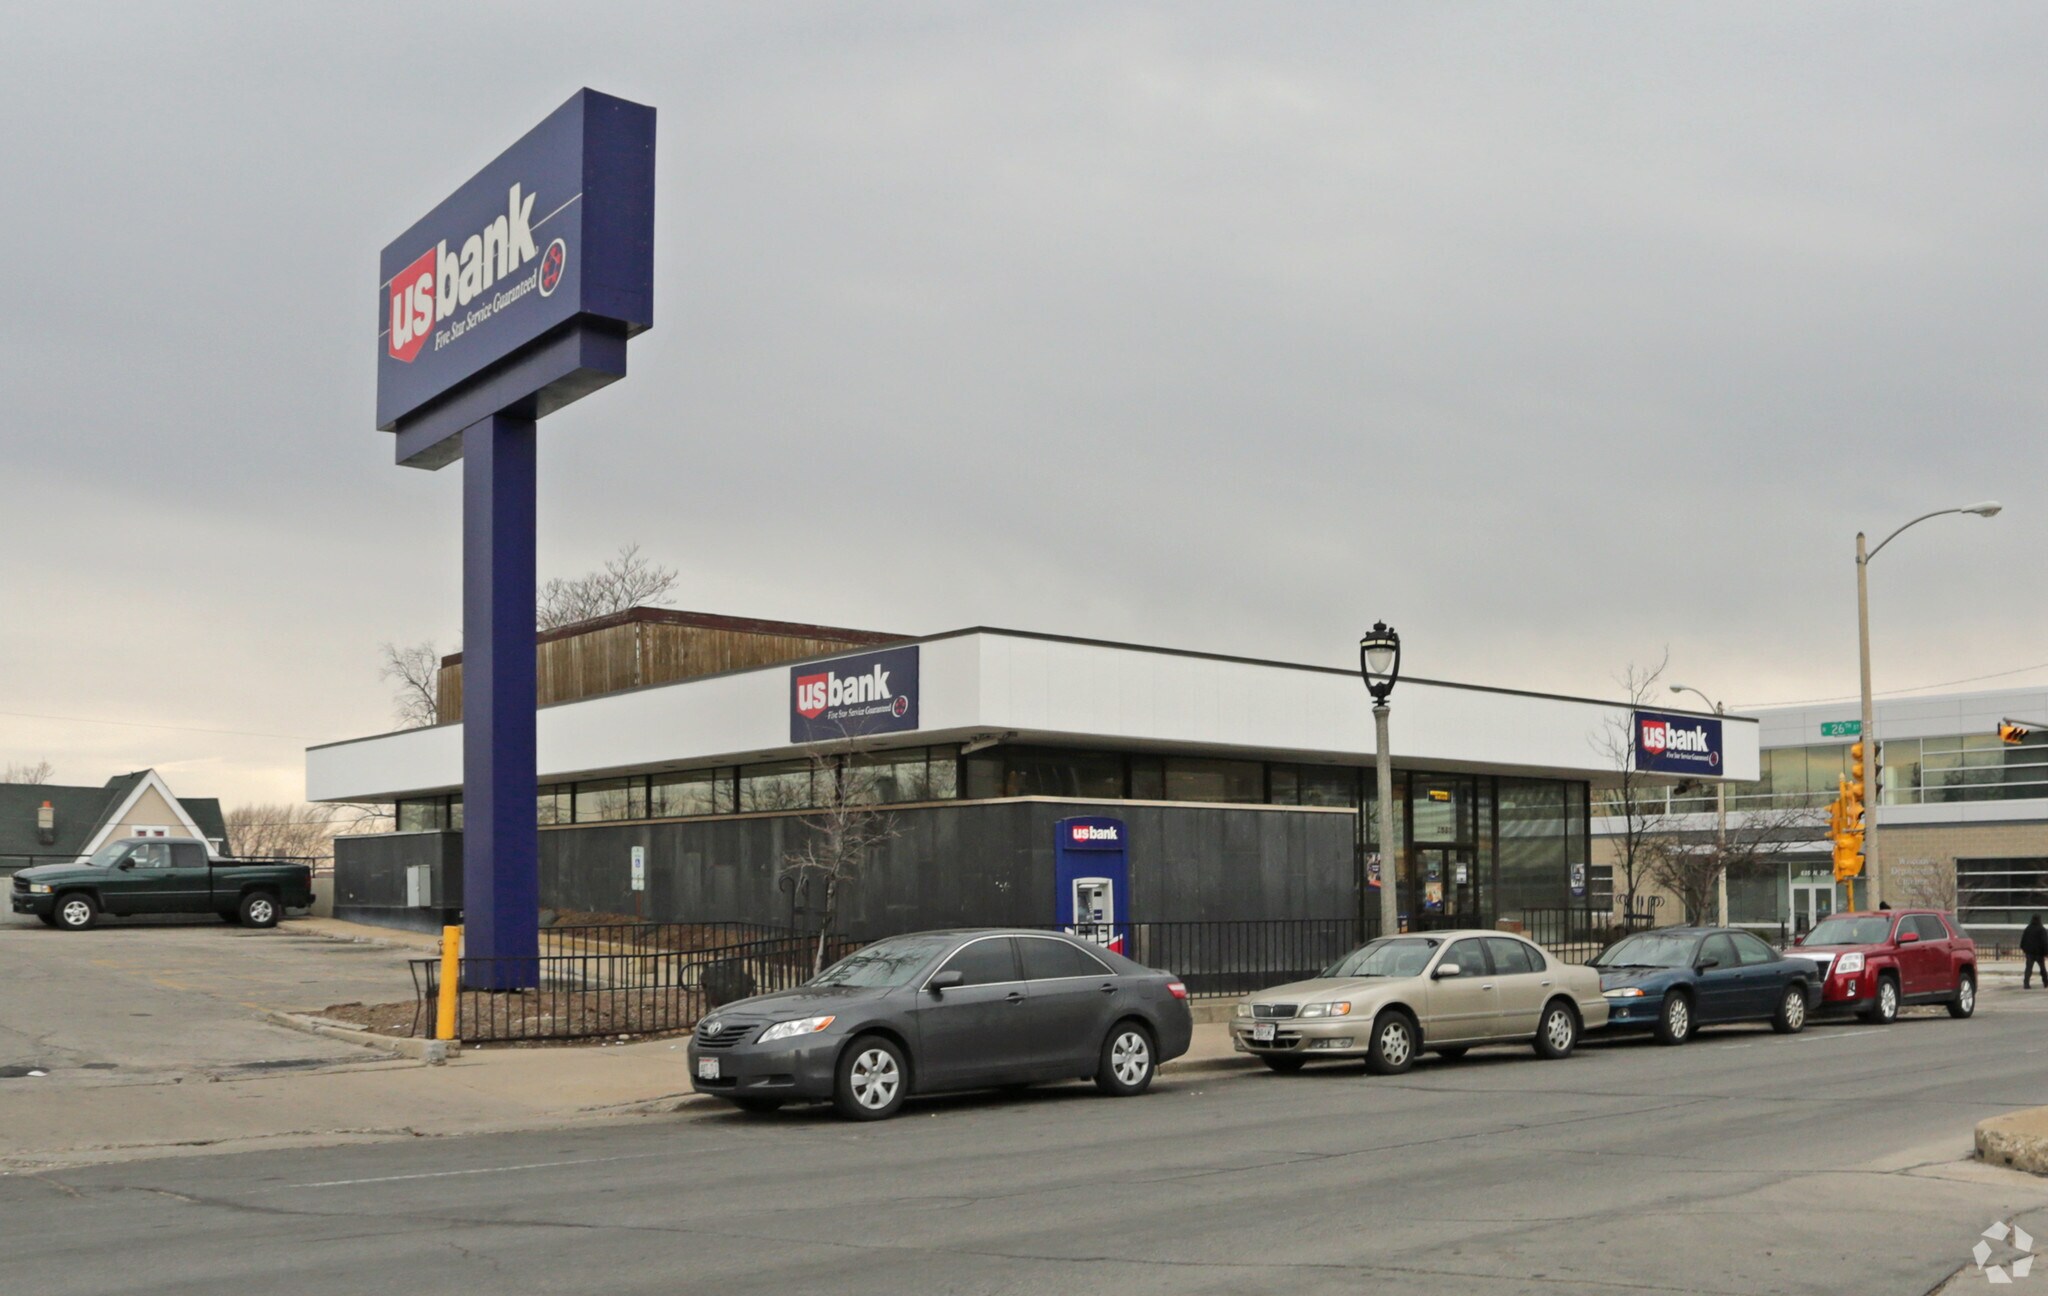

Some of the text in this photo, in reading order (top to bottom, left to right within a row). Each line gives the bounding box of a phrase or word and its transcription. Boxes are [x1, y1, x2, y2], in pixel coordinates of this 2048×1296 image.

[434, 267, 538, 351] Five Star Service Guaranteed
[827, 710, 838, 719] Five
[838, 709, 848, 719] Star
[848, 706, 865, 717] Service
